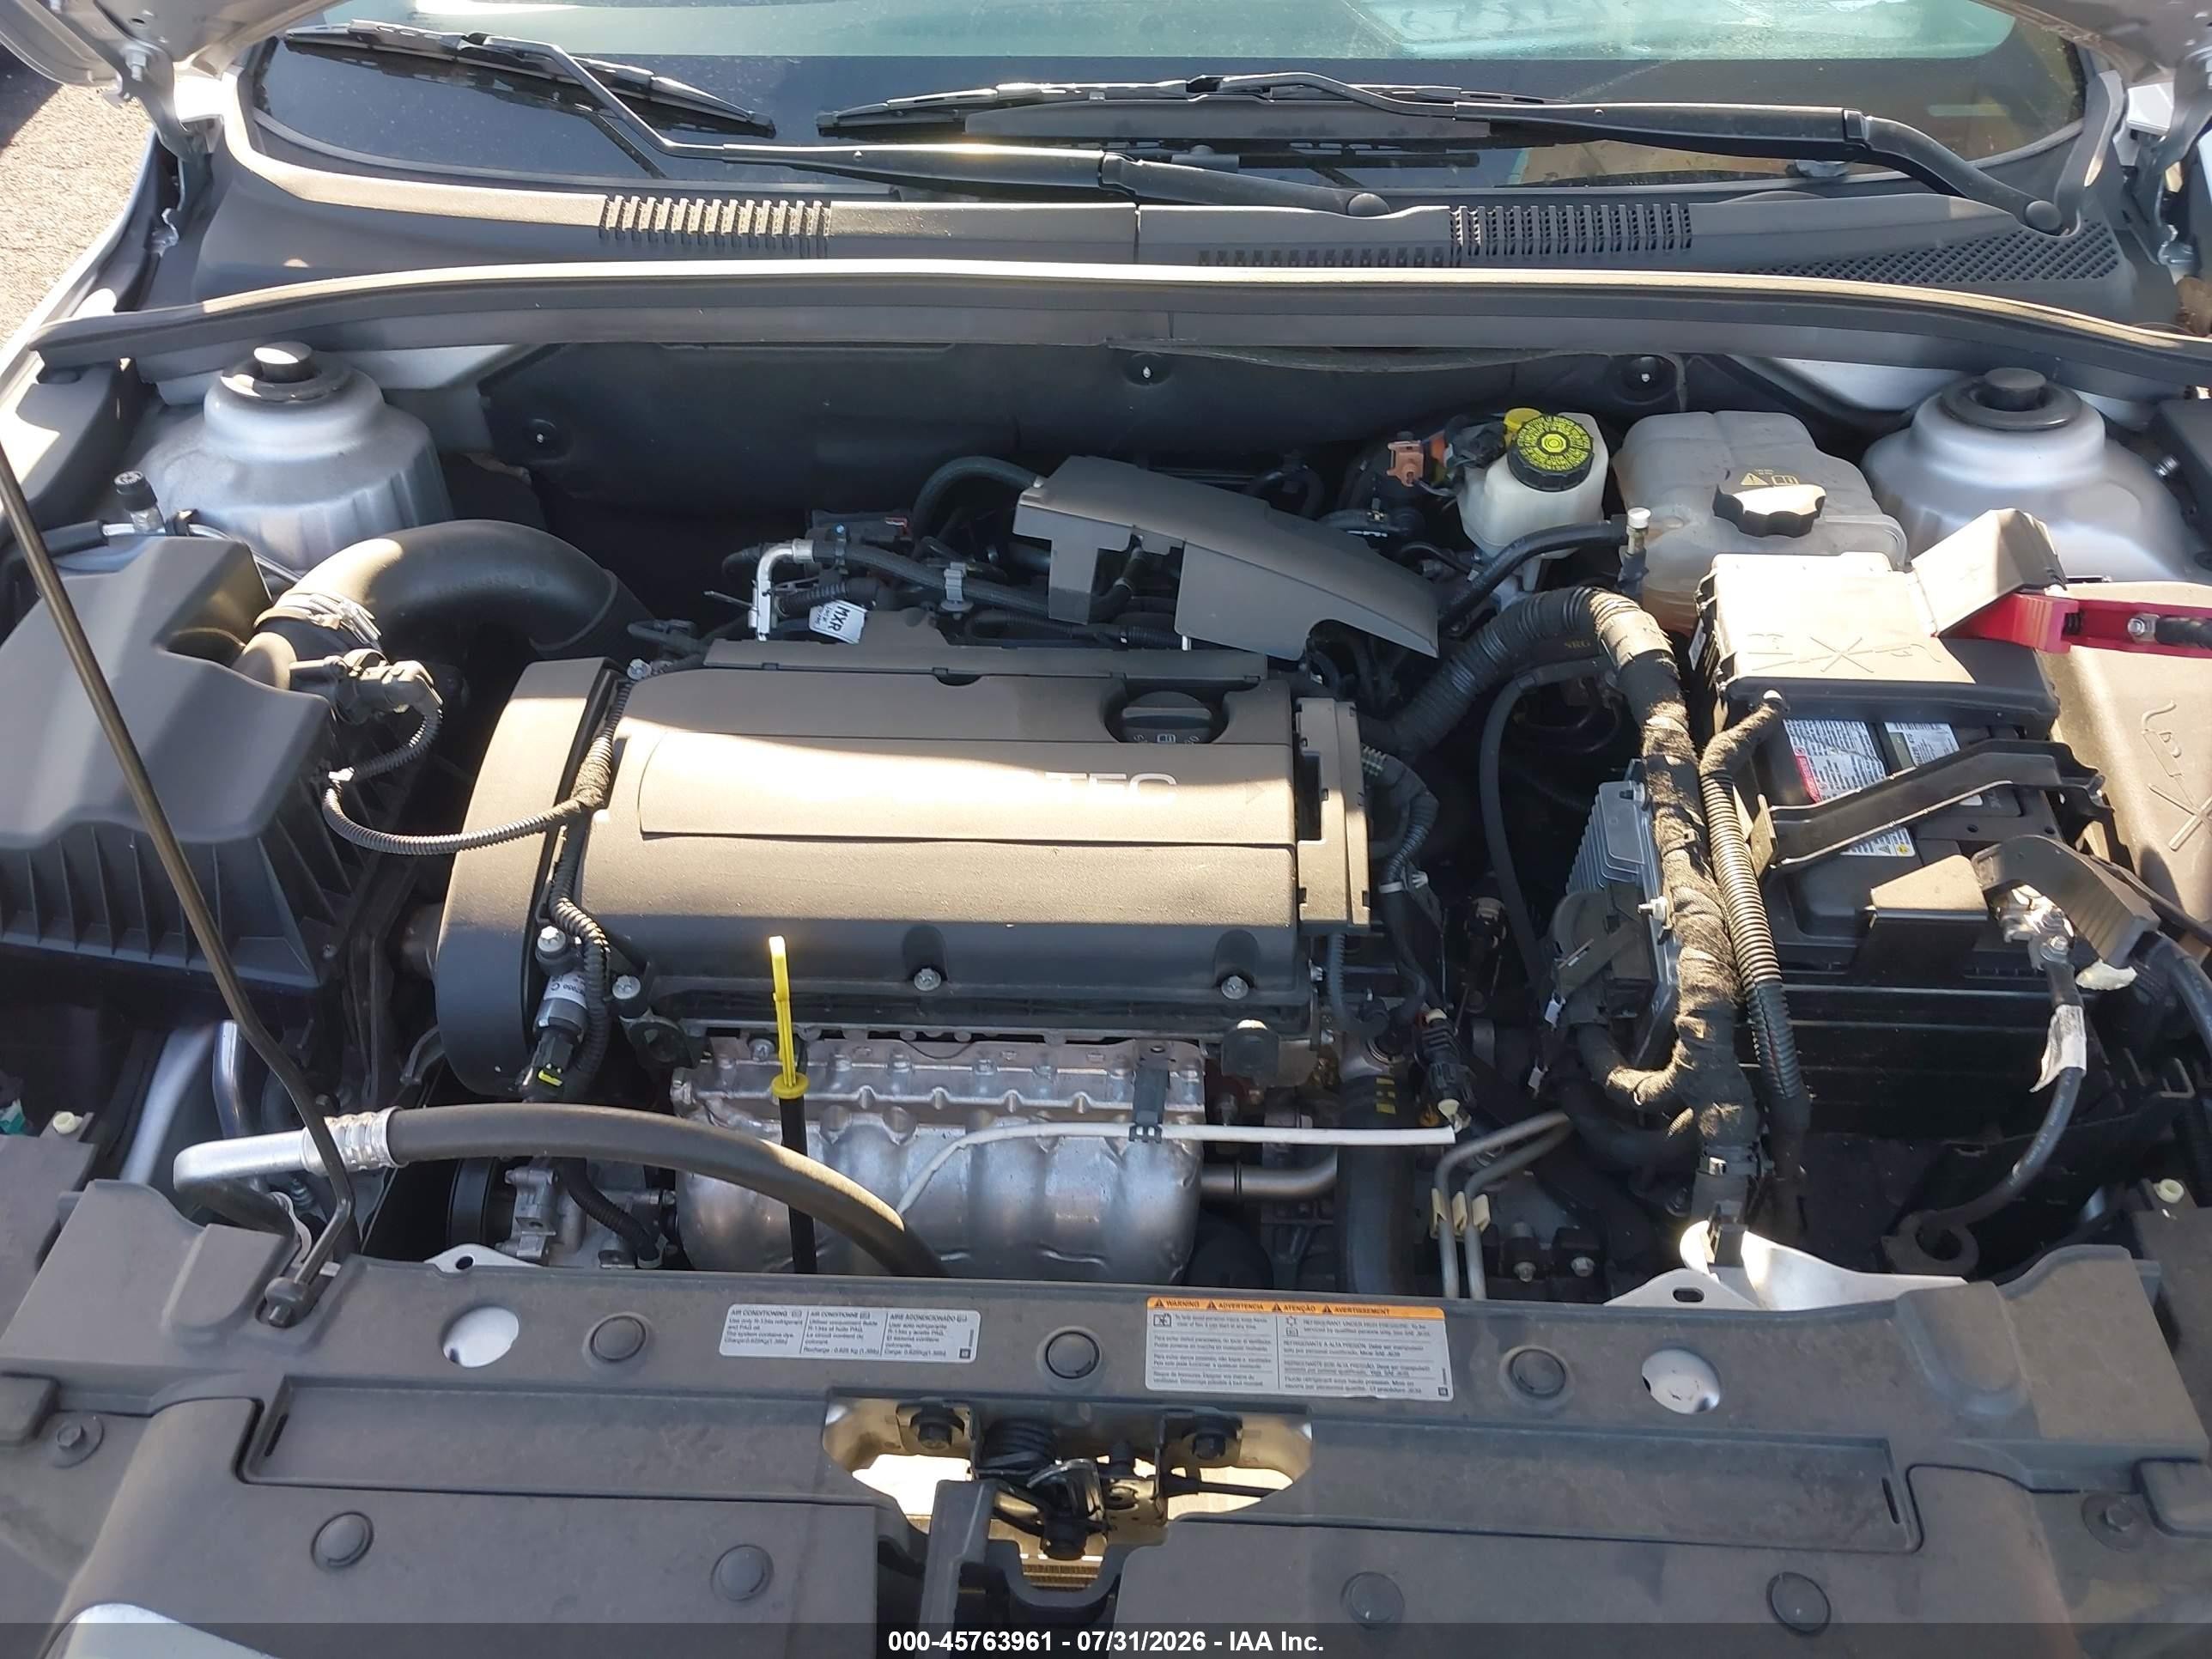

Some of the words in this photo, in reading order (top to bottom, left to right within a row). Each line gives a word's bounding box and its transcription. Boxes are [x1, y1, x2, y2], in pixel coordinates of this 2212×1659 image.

[828, 606, 851, 631] MXR
[1284, 1304, 1316, 1313] ATENÇÃO
[1334, 1307, 1389, 1316] AVERTISSEMENT
